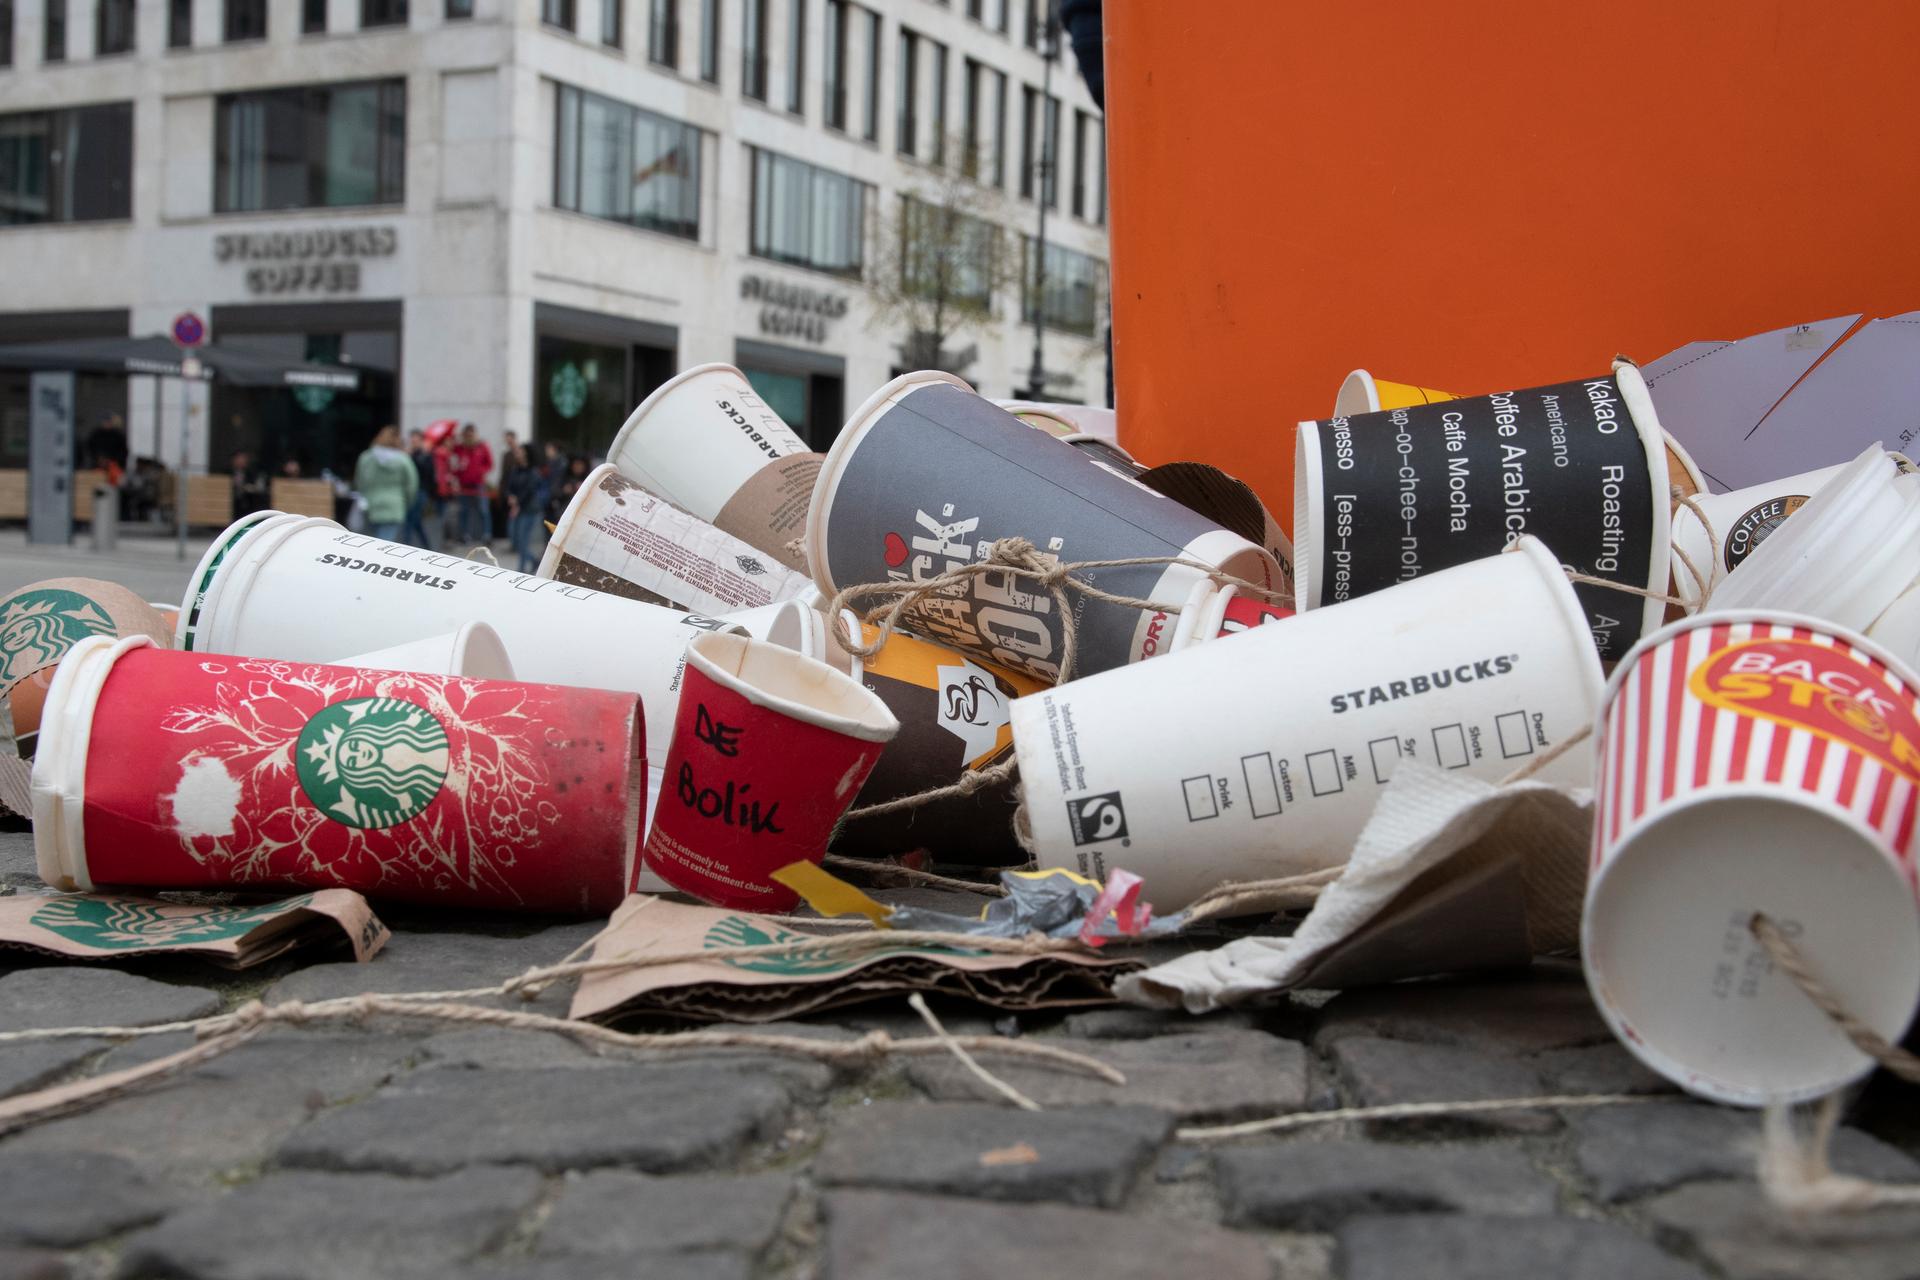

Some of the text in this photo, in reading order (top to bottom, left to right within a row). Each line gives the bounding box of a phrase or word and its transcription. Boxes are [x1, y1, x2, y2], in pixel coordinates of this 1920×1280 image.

[718, 400, 781, 459] ARBUCKS
[1541, 395, 1569, 467] Americano
[1442, 412, 1471, 532] Caffe Mocha
[1583, 380, 1625, 572] Kakao Roasting
[1731, 502, 1780, 555] COFFEE
[1730, 653, 1896, 717] BACK
[1404, 738, 1416, 757] Syr
[1468, 726, 1482, 759] Shots
[1532, 713, 1549, 747] Decaf
[1278, 759, 1294, 803] Custom
[1343, 755, 1358, 781] Milk
[1217, 778, 1232, 810] Drink
[677, 844, 713, 868] extremely
[714, 861, 730, 873] hot.
[678, 857, 690, 867] est
[690, 861, 744, 888] extrêmement
[744, 882, 775, 894] chaude.
